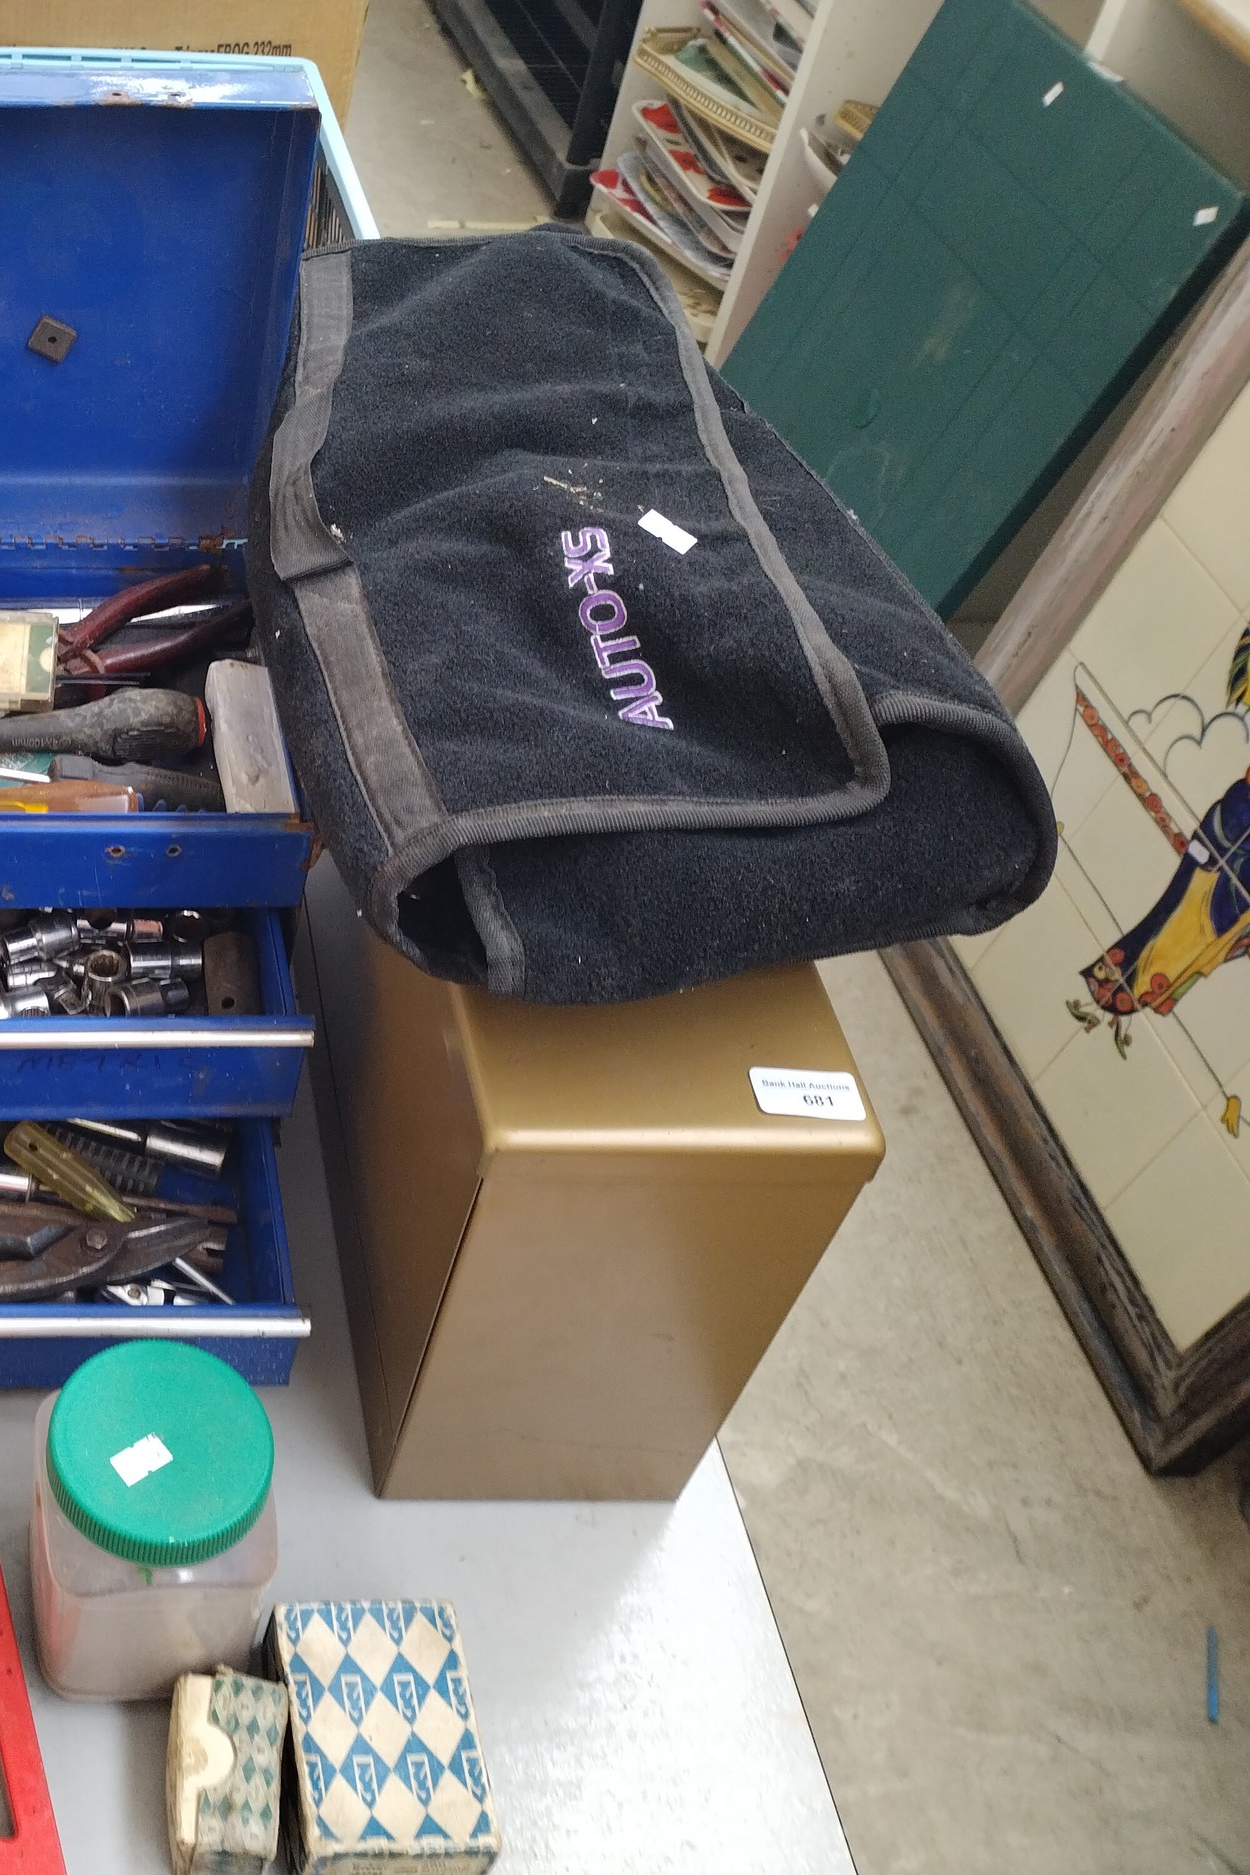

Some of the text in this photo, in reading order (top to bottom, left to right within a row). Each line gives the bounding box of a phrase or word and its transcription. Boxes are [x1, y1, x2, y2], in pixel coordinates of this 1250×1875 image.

[561, 526, 674, 731] AUTO-XS
[762, 1079, 850, 1091] Bank Hall Auctions
[803, 1095, 834, 1107] 681
